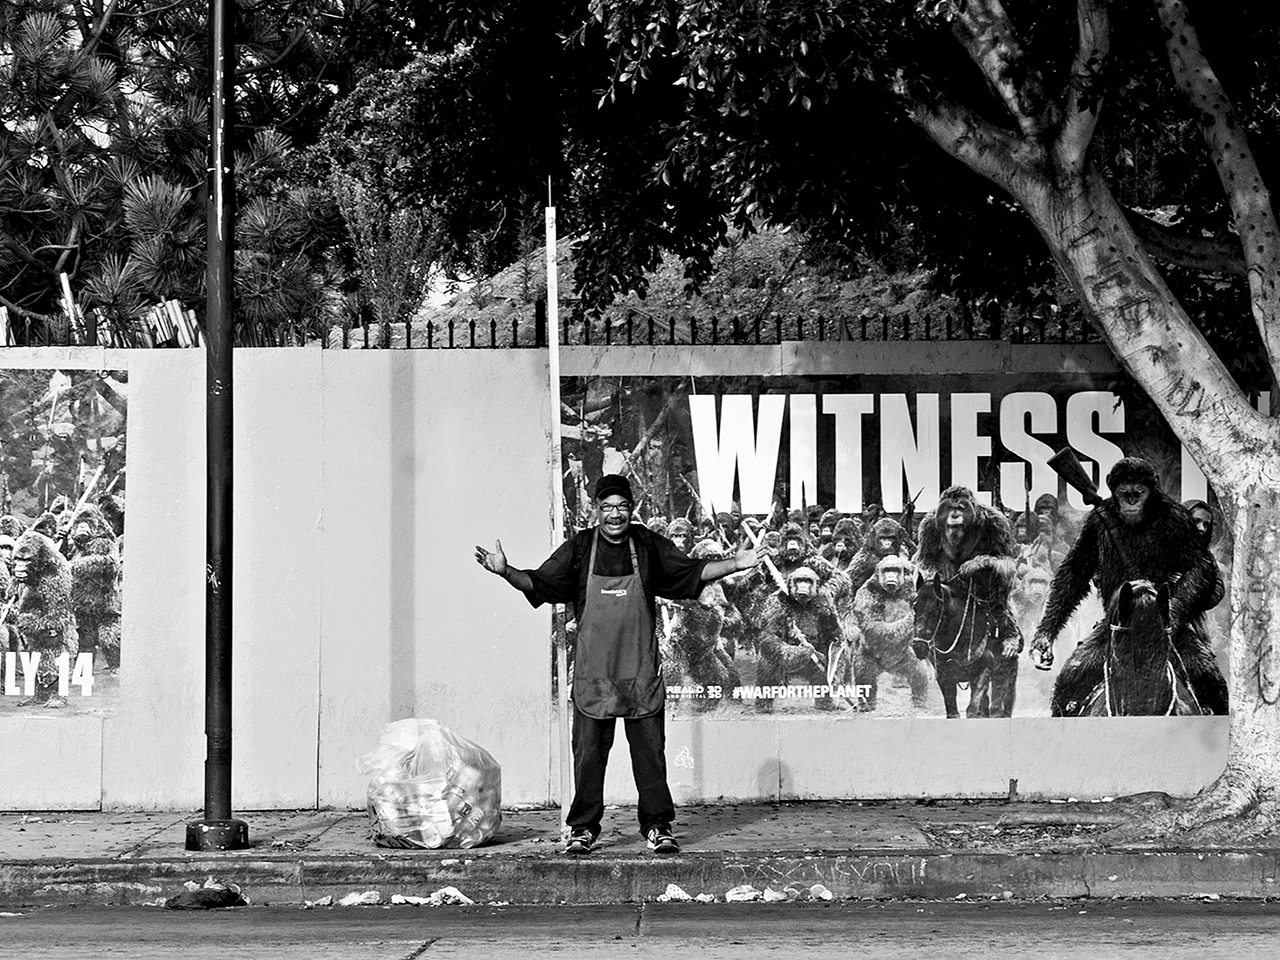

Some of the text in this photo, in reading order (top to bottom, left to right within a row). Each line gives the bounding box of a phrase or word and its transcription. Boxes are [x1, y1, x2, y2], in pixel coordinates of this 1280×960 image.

[689, 391, 1125, 513] WITNESS
[0, 651, 95, 697] LY 14
[732, 684, 872, 699] #WARFORTHEPLANET
